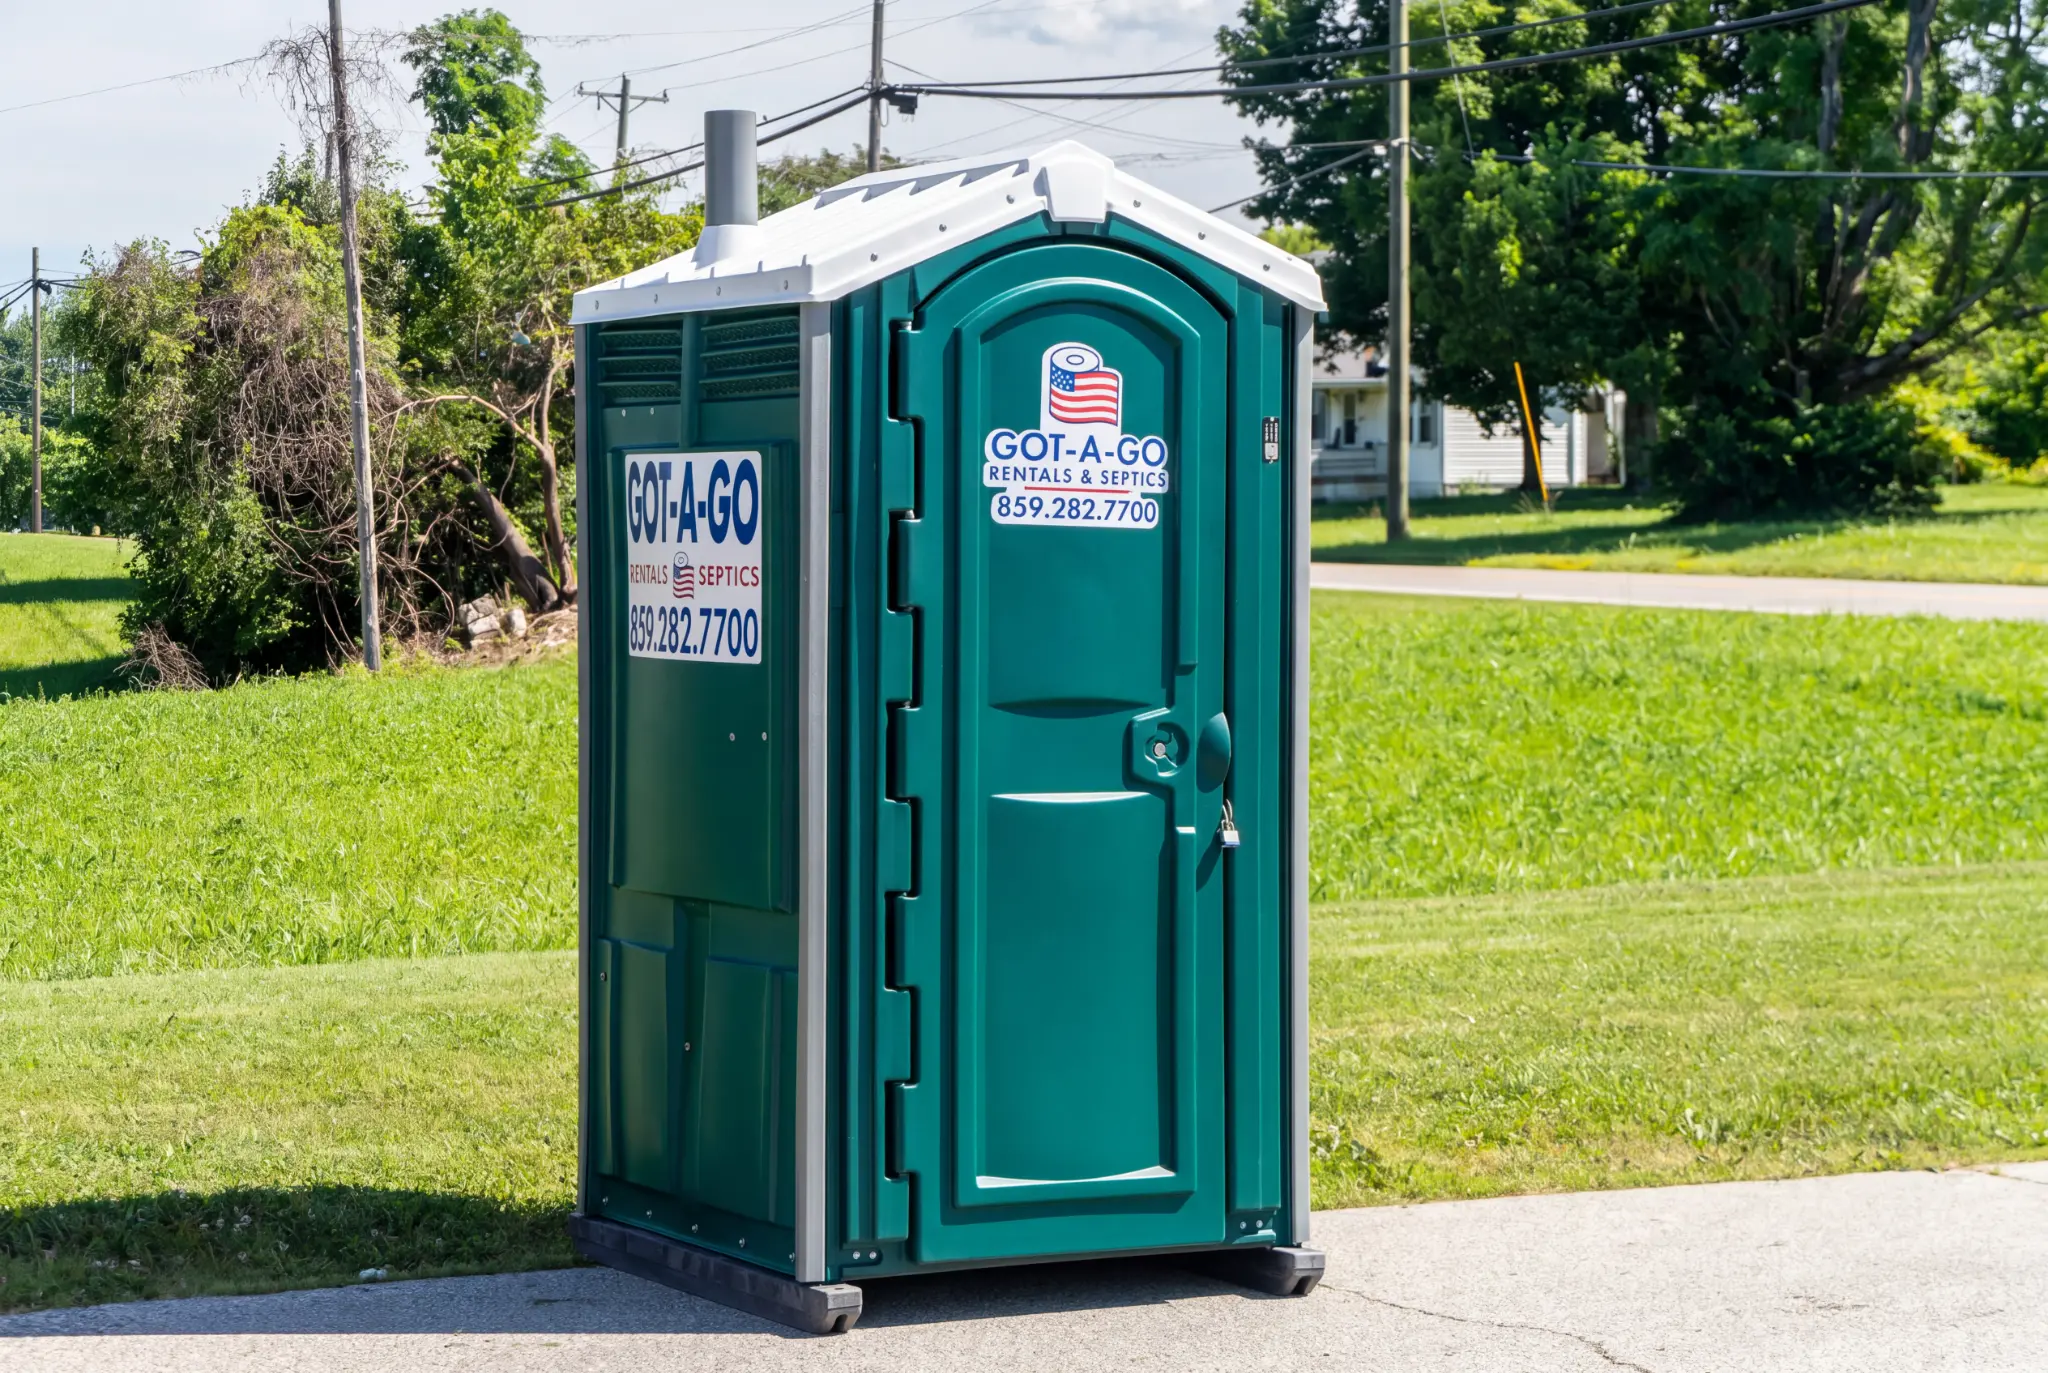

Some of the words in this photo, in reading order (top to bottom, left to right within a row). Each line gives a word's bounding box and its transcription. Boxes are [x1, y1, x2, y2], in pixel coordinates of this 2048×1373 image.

[991, 431, 1166, 467] GOT-A-GO
[989, 466, 1072, 483] RENTALS
[1080, 469, 1093, 484] &
[1100, 470, 1166, 487] SEPTICS
[628, 459, 759, 545] GOT-A-GO
[997, 495, 1157, 523] 859.282.7700
[630, 564, 668, 585] RENTALS
[698, 565, 760, 587] SEPTICS
[630, 604, 758, 657] 859.282.7700
